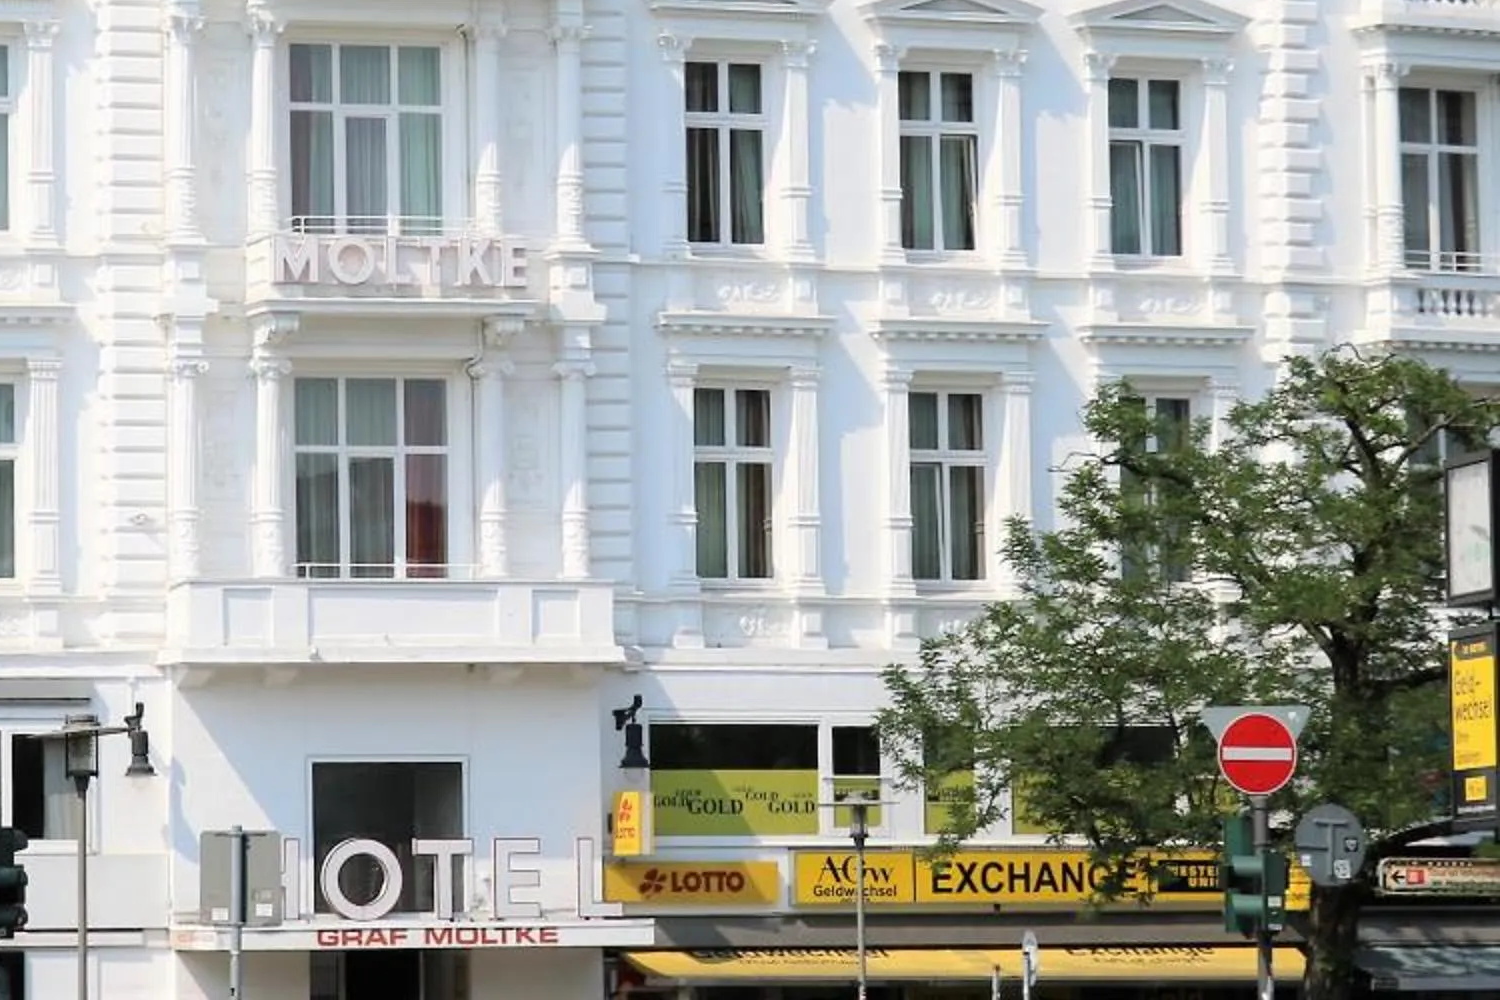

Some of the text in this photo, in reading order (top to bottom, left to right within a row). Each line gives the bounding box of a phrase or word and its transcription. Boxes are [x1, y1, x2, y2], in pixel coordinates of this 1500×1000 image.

[272, 235, 527, 288] MOLTKE
[689, 799, 744, 815] GOLD
[768, 800, 815, 814] GOLD
[672, 871, 745, 893] LOTTO
[813, 885, 897, 897] Geldwchsel
[317, 927, 559, 946] GRAF MOLTKE
